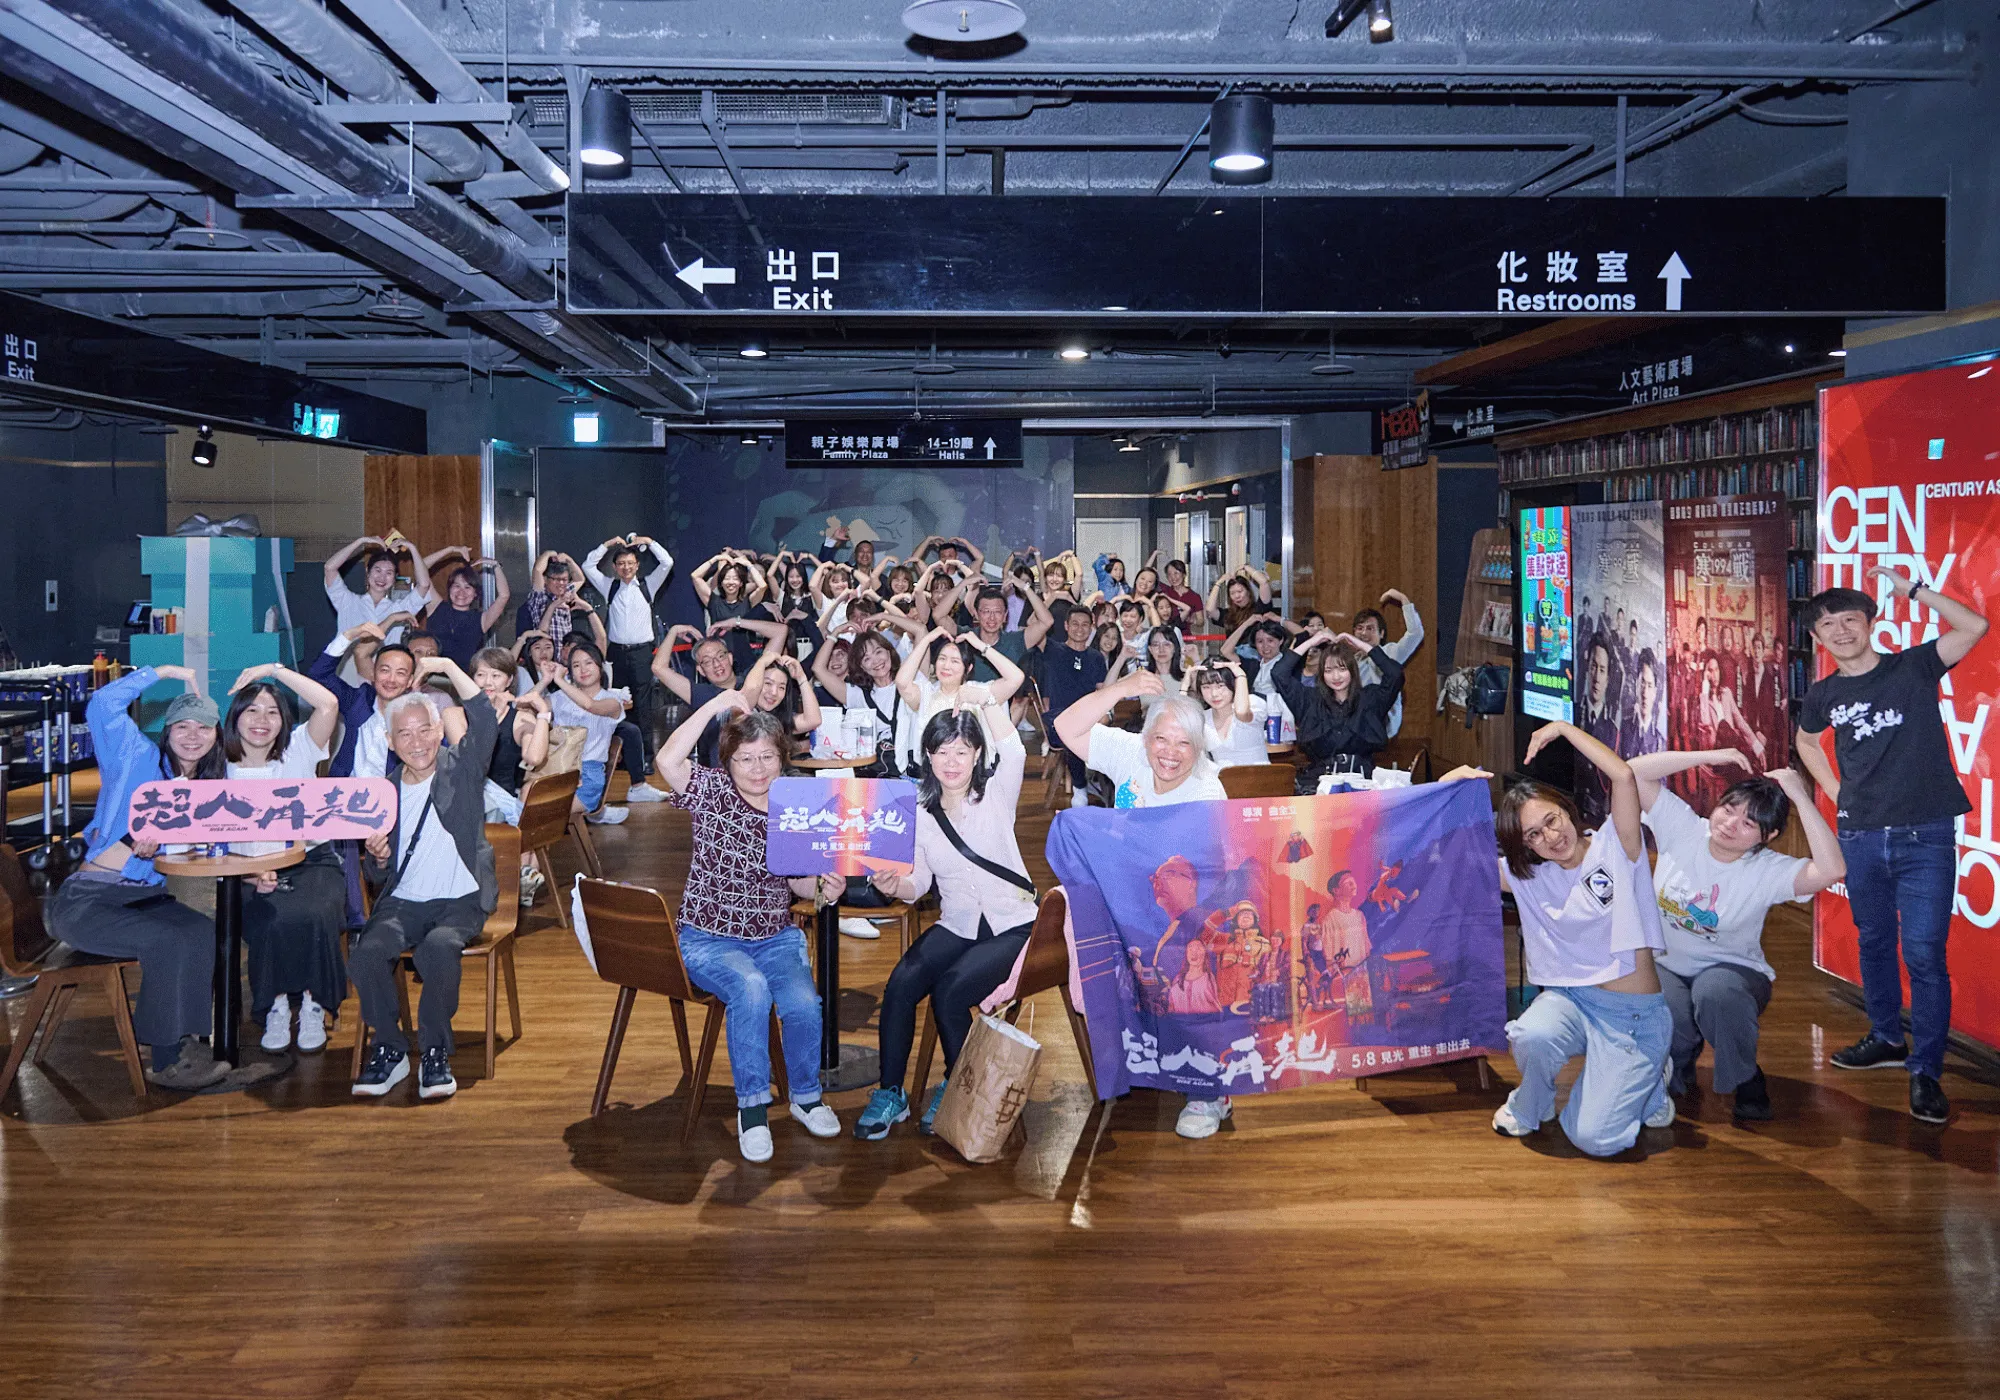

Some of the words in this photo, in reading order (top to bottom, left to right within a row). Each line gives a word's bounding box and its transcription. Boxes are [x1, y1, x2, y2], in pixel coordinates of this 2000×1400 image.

[766, 248, 839, 282] 出口
[1496, 251, 1628, 283] 化妝室
[773, 286, 833, 311] Exit
[1497, 288, 1636, 311] Restrooms
[5, 333, 37, 361] 出口
[8, 360, 35, 381] Exit
[1632, 390, 1648, 404] Art
[1652, 385, 1679, 400] Plaza
[811, 436, 899, 449] 親子娛樂廣場
[823, 450, 857, 460] Family
[861, 450, 889, 459] Plaza
[938, 450, 966, 460] Halls
[1925, 480, 1984, 498] CENTURY
[1825, 484, 1926, 553] CEN
[1351, 1051, 1376, 1069] 5/8
[1381, 1049, 1404, 1065] 見光
[1408, 1045, 1431, 1060] 重生
[1436, 1038, 1470, 1055] 走出去
